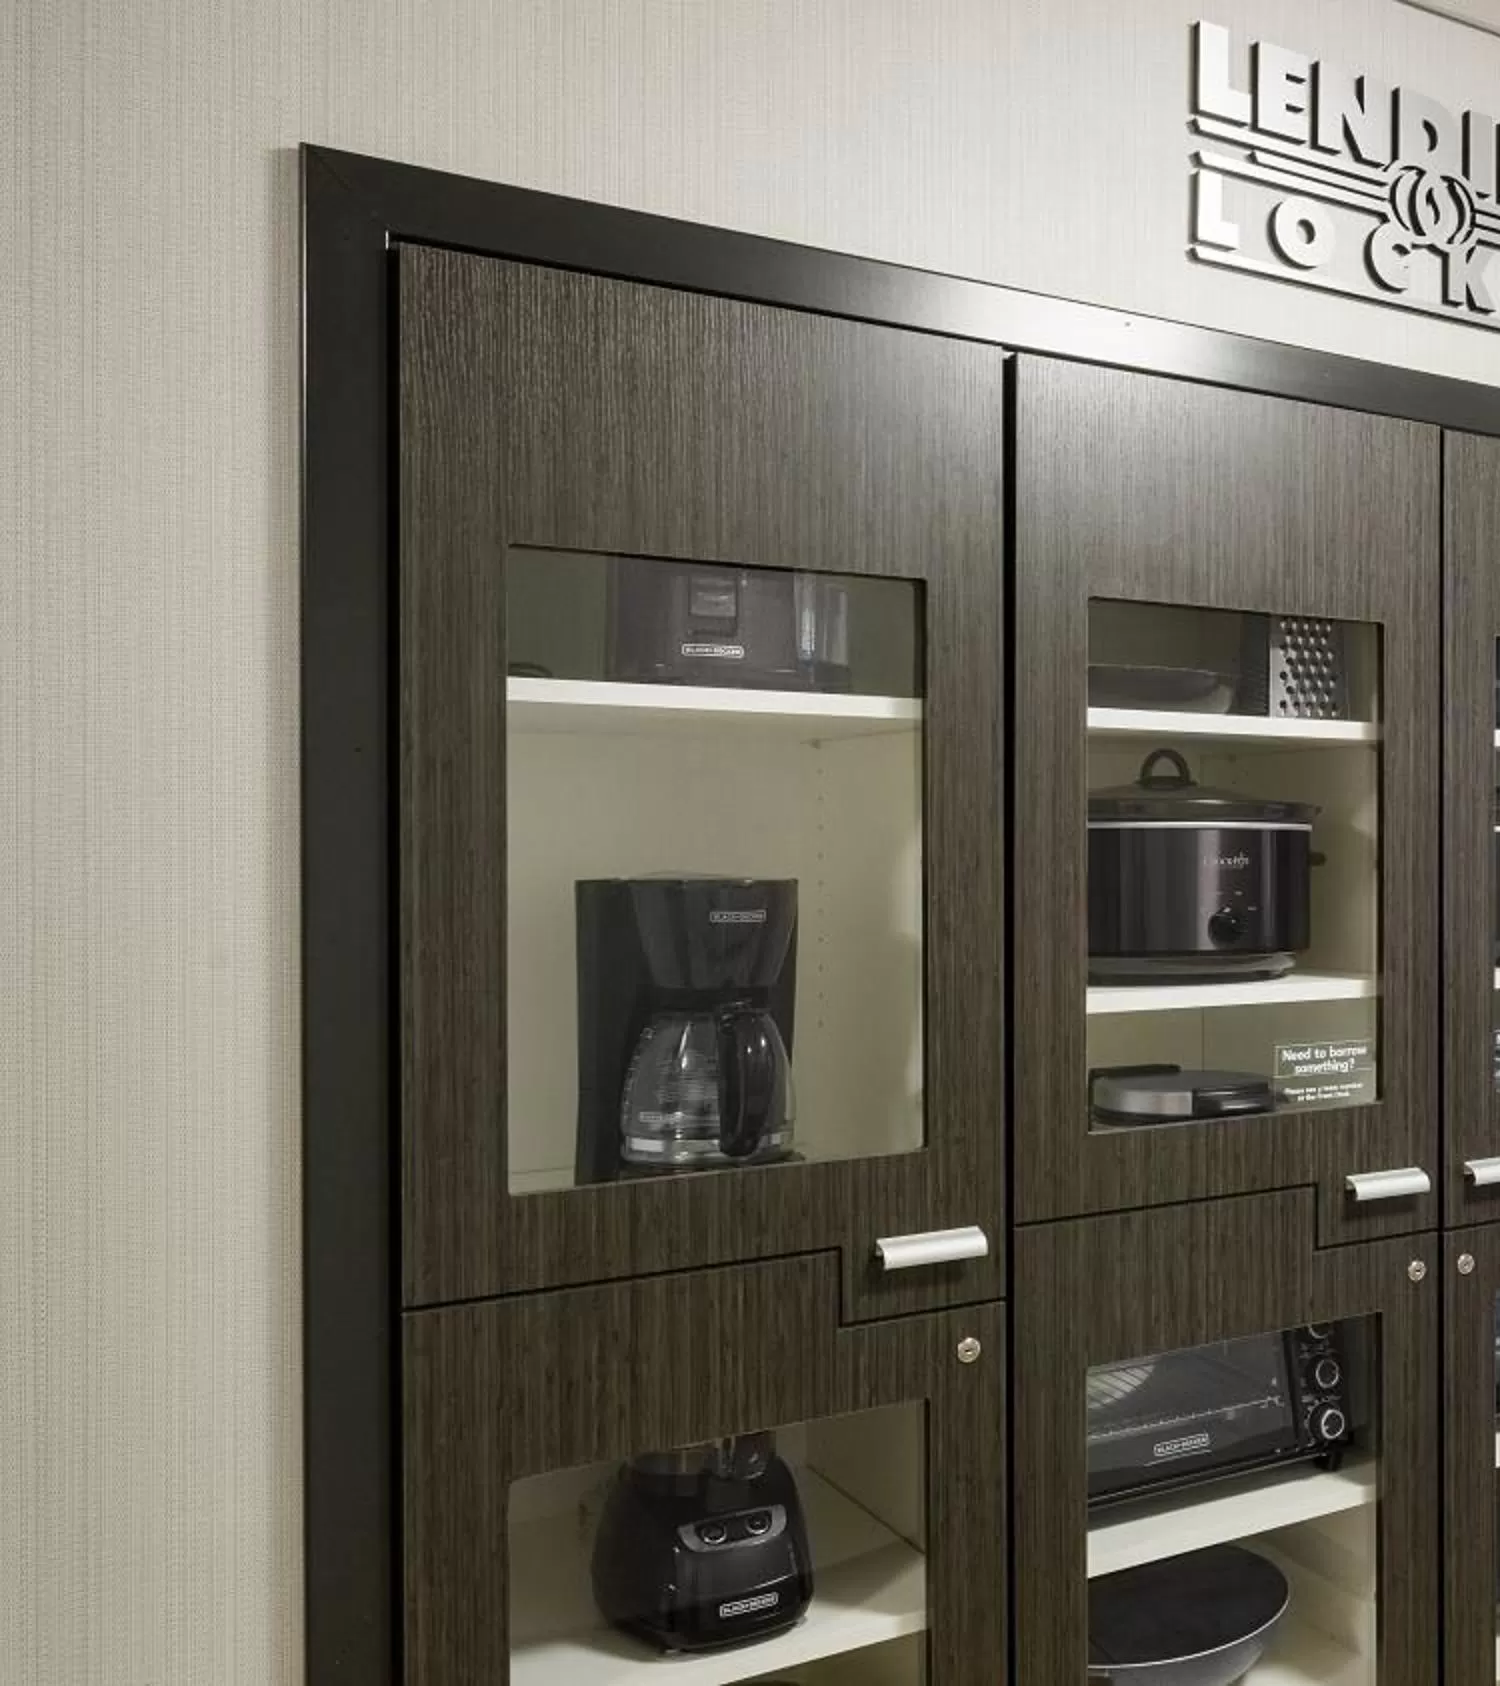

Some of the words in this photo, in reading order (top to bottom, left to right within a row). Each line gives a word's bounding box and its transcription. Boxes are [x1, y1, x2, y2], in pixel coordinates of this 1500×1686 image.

[1282, 1047, 1311, 1061] Need
[1315, 1048, 1327, 1059] to
[1329, 1045, 1367, 1058] borrow
